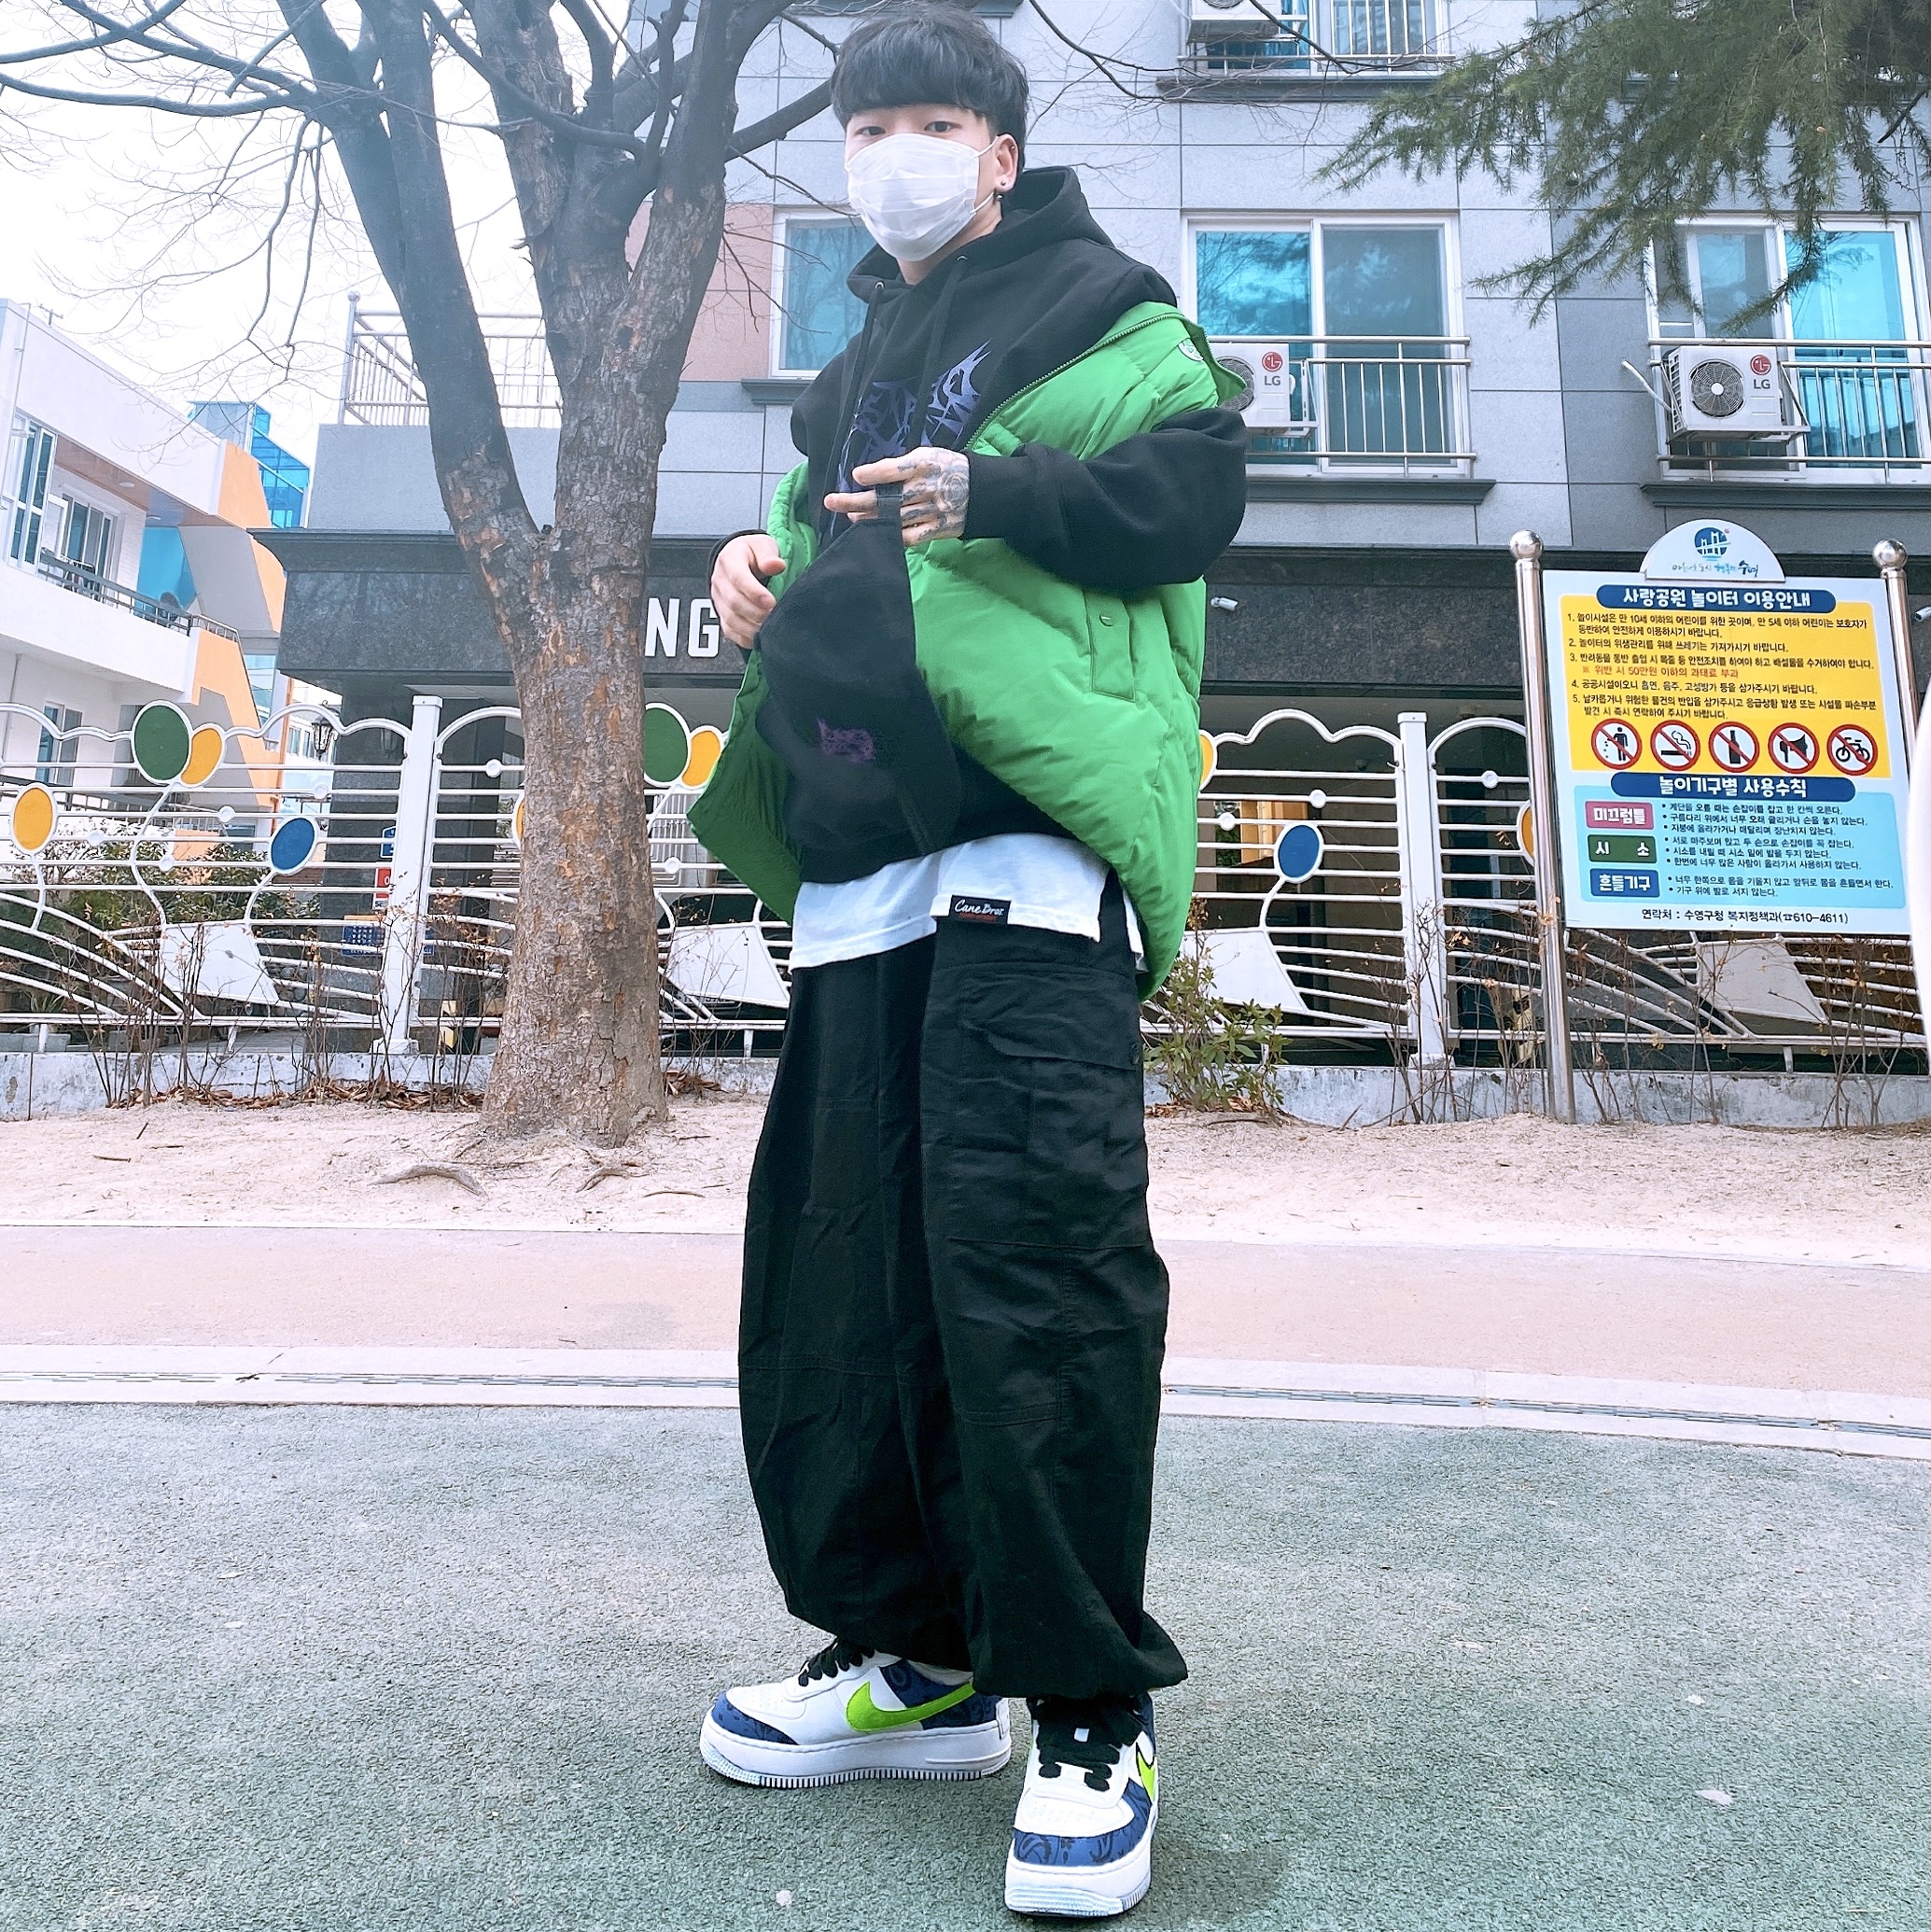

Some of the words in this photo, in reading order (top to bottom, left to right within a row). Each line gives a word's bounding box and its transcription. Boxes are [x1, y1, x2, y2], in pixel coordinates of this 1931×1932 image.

[1264, 375, 1281, 386] LG
[1753, 379, 1770, 389] LG
[1623, 588, 1686, 608] 사랑공원
[1691, 590, 1738, 609] 놀이터
[1743, 590, 1811, 609] 이용안내
[1567, 612, 1574, 622] 1.
[1649, 614, 1673, 623] 이하의
[1675, 615, 1706, 625] 어린이를
[1710, 616, 1726, 625] 위한
[1783, 617, 1799, 626] 이하
[1801, 617, 1834, 627] 어린이는
[1836, 618, 1867, 628] 보호자가
[1612, 625, 1644, 636] 안전하게
[1646, 625, 1686, 636] 이용하시기
[1568, 637, 1576, 647] 2.
[1578, 637, 1611, 648] 놀이터의
[1614, 638, 1653, 649] 위생관리를
[1657, 639, 1672, 649] 위해
[1675, 640, 1707, 651] 쓰레기는
[1710, 641, 1750, 651] 가져가시기
[1569, 651, 1577, 661] 3.
[1649, 654, 1658, 664] 시
[1677, 654, 1686, 664] 등
[1687, 655, 1726, 665] 안전조치를
[1728, 656, 1752, 665] 하여야
[1754, 657, 1770, 666] 하고
[1806, 657, 1845, 667] 수거하여야
[1847, 658, 1874, 668] 합니다.
[1595, 665, 1612, 674] 위반
[1616, 665, 1624, 675] 시
[1628, 665, 1657, 676] 50만원
[1660, 666, 1686, 676] 이하의
[1690, 667, 1717, 677] 과태료
[1720, 668, 1738, 678] 부과
[1571, 679, 1579, 688] 4.
[1581, 679, 1638, 689] 공공시설이오니
[1685, 681, 1717, 692] 고성방가
[1719, 681, 1736, 691] 등을
[1738, 682, 1779, 693] 삼가주시기
[1573, 693, 1580, 703] 5.
[1625, 694, 1649, 704] 위험한
[1651, 695, 1675, 705] 물건의
[1677, 695, 1701, 705] 반입을
[1703, 696, 1743, 707] 삼가주시고
[1799, 699, 1815, 708] 또는
[1584, 706, 1600, 715] 발견
[1602, 706, 1611, 715] 시
[1613, 707, 1630, 716] 즉시
[1632, 707, 1664, 718] 연락하여
[1667, 708, 1691, 718] 주시기
[1659, 776, 1738, 796] 놀이기구별
[1743, 777, 1807, 798] 사용수칙
[1593, 807, 1645, 825] 미끄럼틀
[1695, 803, 1711, 812] 오를
[1714, 804, 1729, 813] 때는
[1732, 804, 1764, 814] 손잡이를
[1767, 805, 1784, 814] 잡고
[1786, 805, 1794, 814] 한
[1797, 805, 1813, 815] 칸씩
[1815, 805, 1842, 816] 오른다.
[1703, 814, 1728, 823] 위에서
[1730, 814, 1746, 823] 너무
[1749, 815, 1765, 824] 오래
[1802, 815, 1819, 824] 손을
[1773, 825, 1806, 835] 장난치지
[1672, 835, 1688, 845] 서로
[1690, 836, 1721, 846] 마주보며
[1742, 837, 1752, 847] 두
[1754, 837, 1779, 847] 손으로
[1781, 838, 1812, 848] 손잡이를
[1827, 838, 1854, 848] 잡는다.
[1672, 847, 1696, 856] 시소를
[1717, 847, 1726, 856] 때
[1728, 847, 1744, 857] 시소
[1747, 847, 1763, 857] 밑에
[1766, 848, 1783, 858] 발을
[1784, 848, 1801, 858] 두지
[1673, 857, 1697, 866] 한번에
[1700, 858, 1715, 866] 너무
[1718, 858, 1734, 867] 많은
[1737, 859, 1761, 868] 사람이
[1764, 859, 1797, 869] 올라가서
[1798, 860, 1832, 869] 사용하지
[1599, 874, 1650, 891] 흔들기구
[1674, 875, 1691, 884] 너무
[1773, 877, 1790, 887] 않고
[1874, 879, 1894, 889] 한다.
[1676, 885, 1692, 894] 기구
[1694, 886, 1711, 895] 위에
[1713, 887, 1729, 895] 발로
[1732, 887, 1748, 896] 서지
[1642, 909, 1672, 920] 연락처
[1684, 910, 1724, 921] 수영구청
